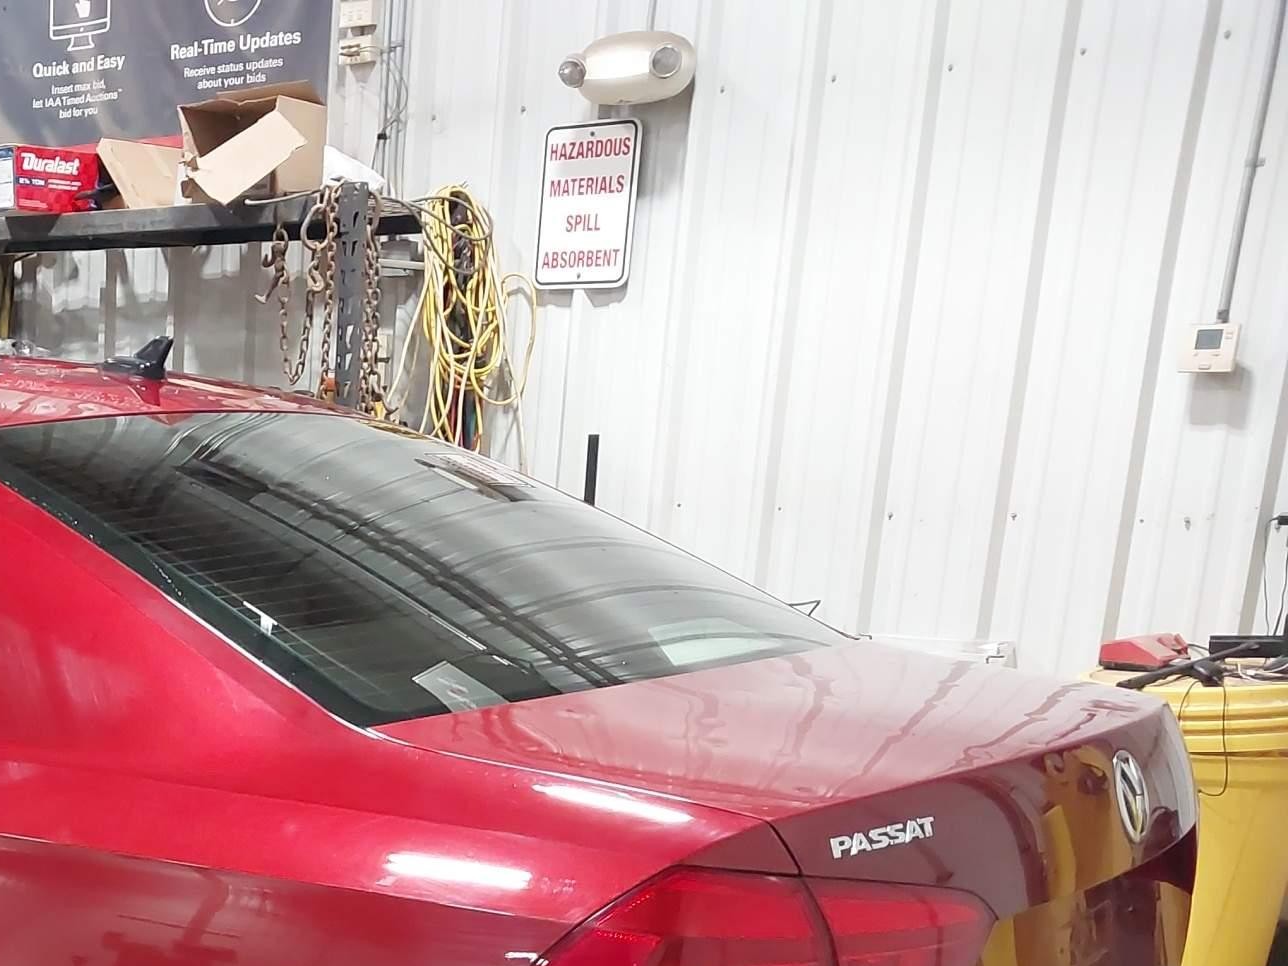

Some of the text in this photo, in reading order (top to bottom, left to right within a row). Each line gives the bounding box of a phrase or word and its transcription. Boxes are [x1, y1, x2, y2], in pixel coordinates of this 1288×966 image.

[170, 31, 302, 60] Real-Time Updates
[33, 55, 125, 78] Quick and Easy
[184, 58, 283, 78] Receive status updates
[51, 84, 73, 95] Insert
[197, 72, 266, 89] about your bids
[45, 97, 61, 107] IAA
[59, 109, 72, 119] bid
[84, 107, 98, 117] you
[550, 136, 631, 162] HAZARDOUS
[21, 152, 80, 176] Duralast
[549, 174, 625, 198] MATERIALS
[565, 213, 601, 233] SPILL
[542, 249, 620, 269] ABSORBENT
[830, 816, 934, 859] PASSAT
